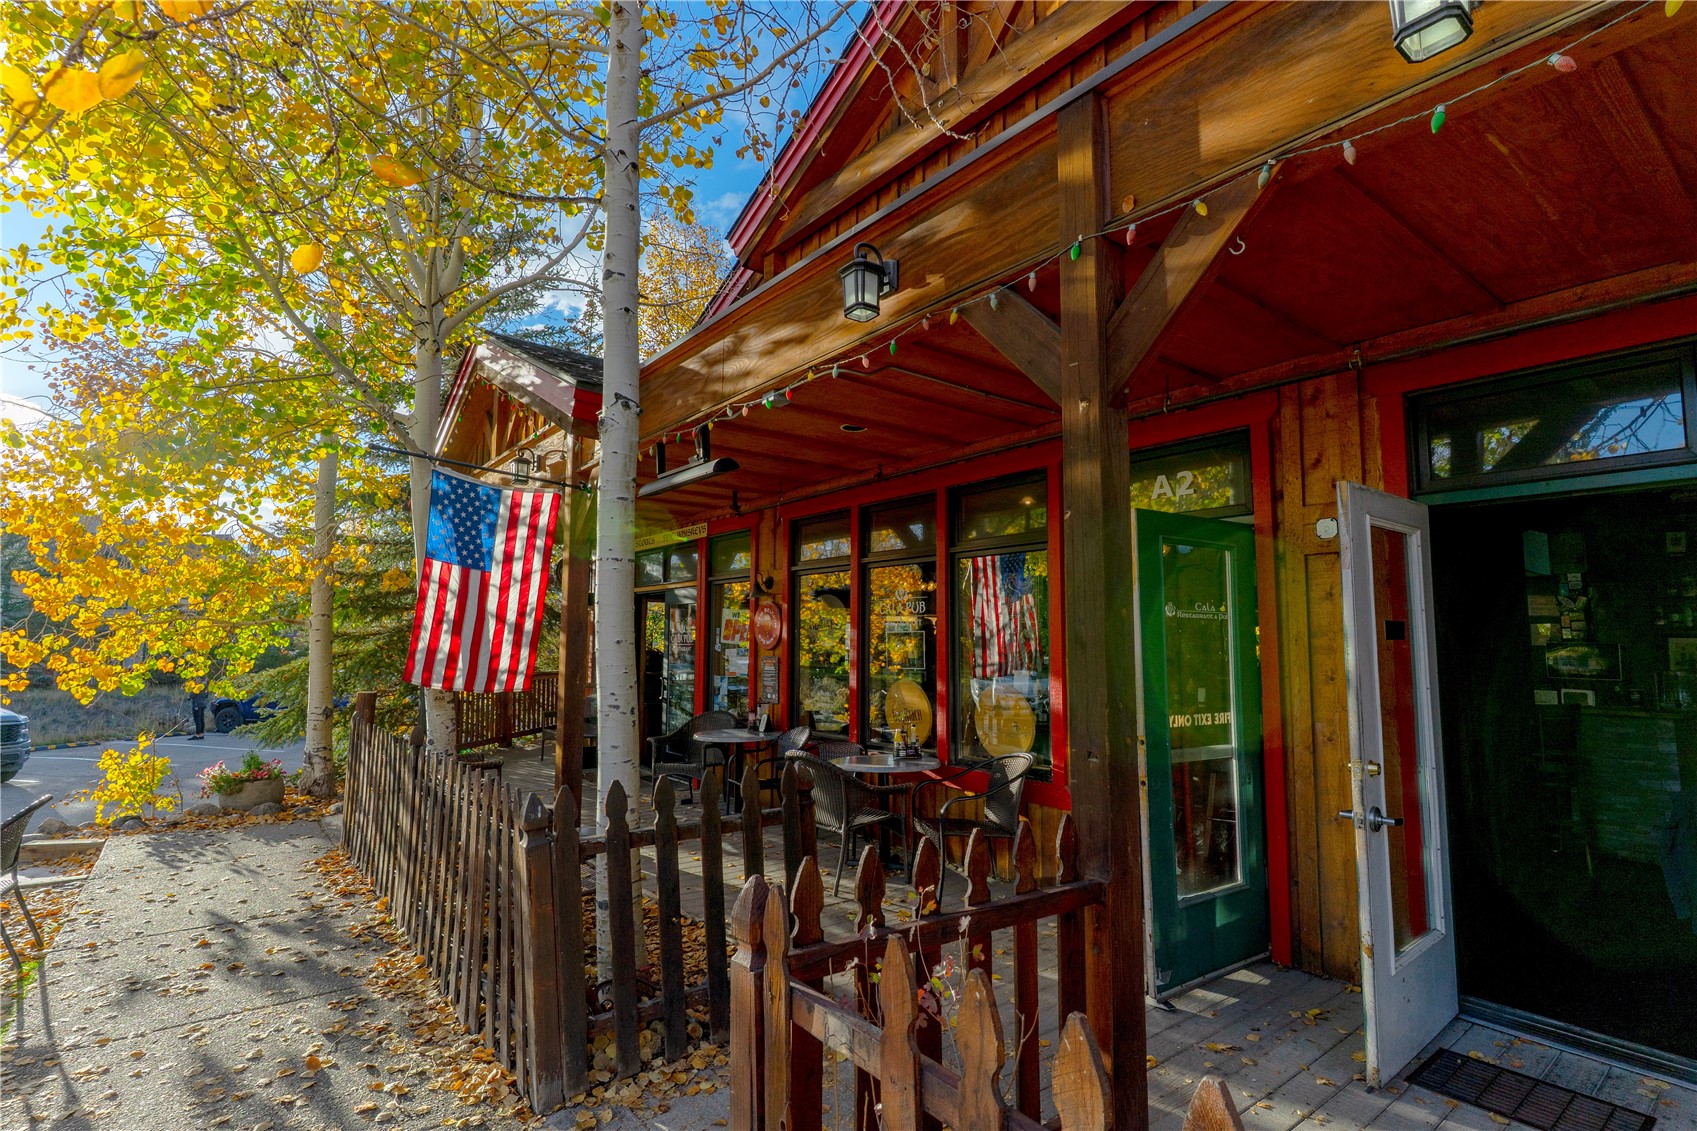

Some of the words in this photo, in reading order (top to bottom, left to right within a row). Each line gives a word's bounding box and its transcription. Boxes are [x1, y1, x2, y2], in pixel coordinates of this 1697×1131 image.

[1151, 471, 1194, 500] A2
[906, 601, 926, 614] PUB
[723, 618, 750, 641] OPE
